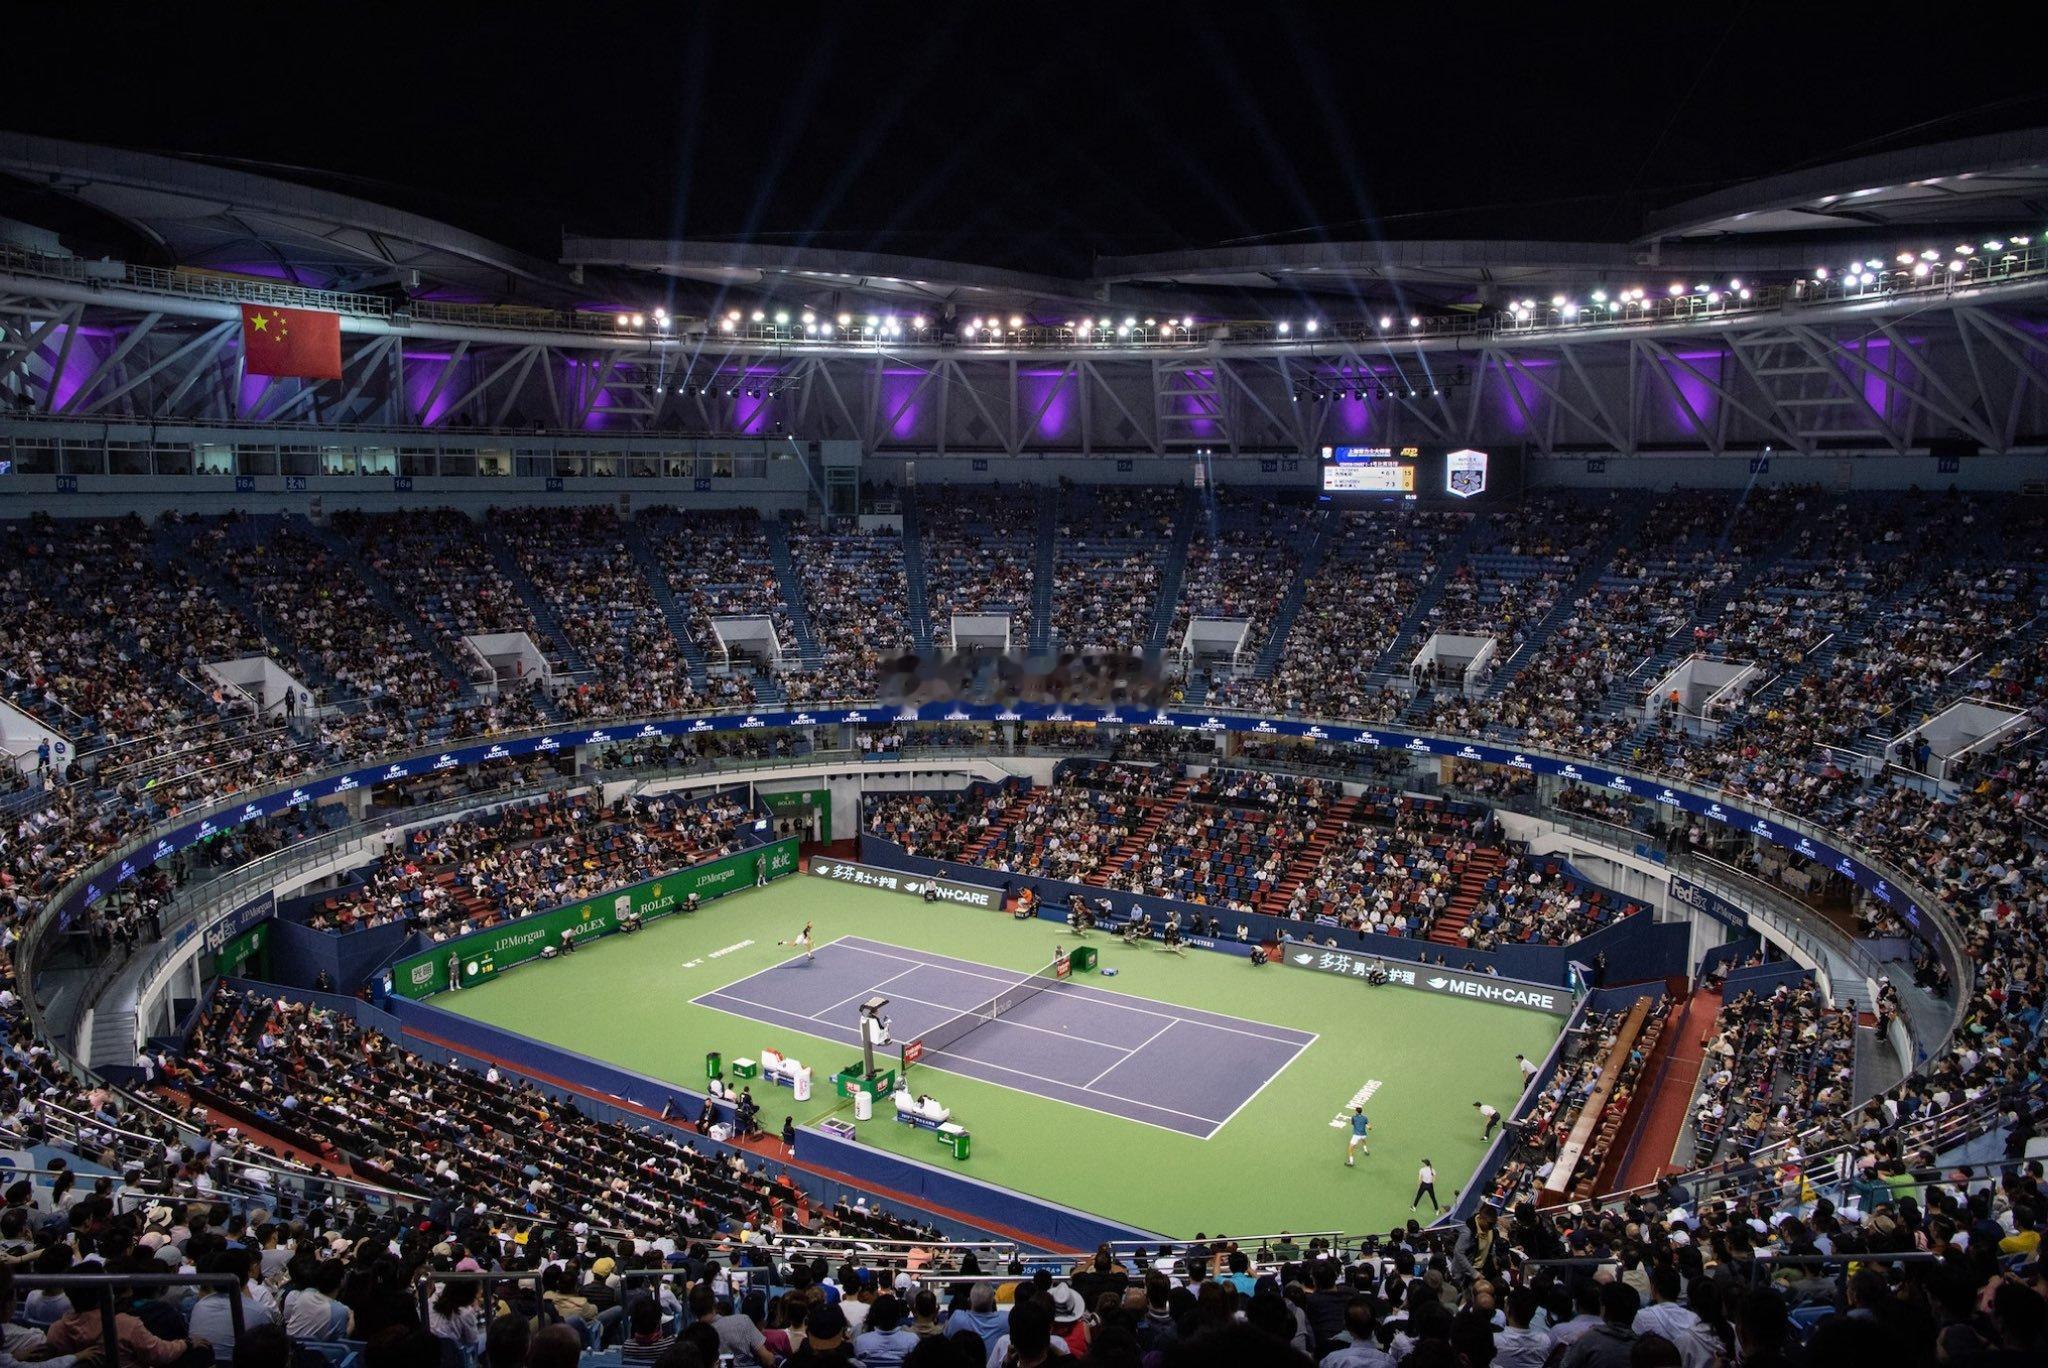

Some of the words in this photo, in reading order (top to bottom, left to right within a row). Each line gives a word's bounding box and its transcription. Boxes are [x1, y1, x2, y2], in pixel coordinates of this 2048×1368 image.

[58, 478, 77, 489] 01B
[237, 479, 254, 488] 16A
[548, 480, 562, 488] 15A
[740, 720, 765, 728] LACOSTE
[842, 715, 867, 723] LACOSTE
[1098, 716, 1123, 724] LACOSTE
[1149, 718, 1175, 726] LACOSTE
[688, 724, 713, 733] LACOSTE
[1201, 722, 1226, 730] LACOSTE
[1252, 726, 1277, 734] LACOSTE
[637, 729, 662, 738] LACOSTE
[1303, 731, 1328, 739] LACOSTE
[586, 735, 611, 744] LACOSTE
[1354, 737, 1379, 745] LACOSTE
[535, 741, 560, 751] LACOSTE
[1405, 743, 1430, 752] LACOSTE
[484, 749, 509, 760] LACOSTE
[1457, 751, 1482, 760] LACOSTE
[433, 758, 458, 769] LACOSTE
[1507, 760, 1532, 769] LACOSTE
[384, 769, 408, 780] LACOSTE
[1558, 769, 1583, 781] LACOSTE
[334, 780, 359, 792] LACOSTE
[1608, 781, 1632, 793] LACOSTE
[286, 794, 310, 807] LACOSTE
[1656, 794, 1680, 807] LACOSTE
[239, 808, 263, 823] LACOSTE
[1704, 809, 1727, 823] LACOSTE
[195, 825, 217, 841] LACOSTE
[1750, 825, 1773, 839] LACOSTE
[152, 844, 174, 861] LACOSTE
[1794, 843, 1816, 859] LACOSTE
[832, 864, 855, 880] 多芬
[854, 871, 897, 890] 男士+护理
[1836, 864, 1856, 880] LACOSTE
[918, 883, 989, 906] MN+CARE
[1671, 879, 1708, 911] FedEx
[641, 895, 675, 914] ROLEX
[574, 917, 606, 936] OLEX
[206, 918, 238, 953] FedEx
[494, 929, 546, 952] J.P.Morgan
[1319, 952, 1352, 973] 多芬
[1353, 961, 1415, 986] 男护理
[1449, 979, 1554, 1010] MEN+CARE
